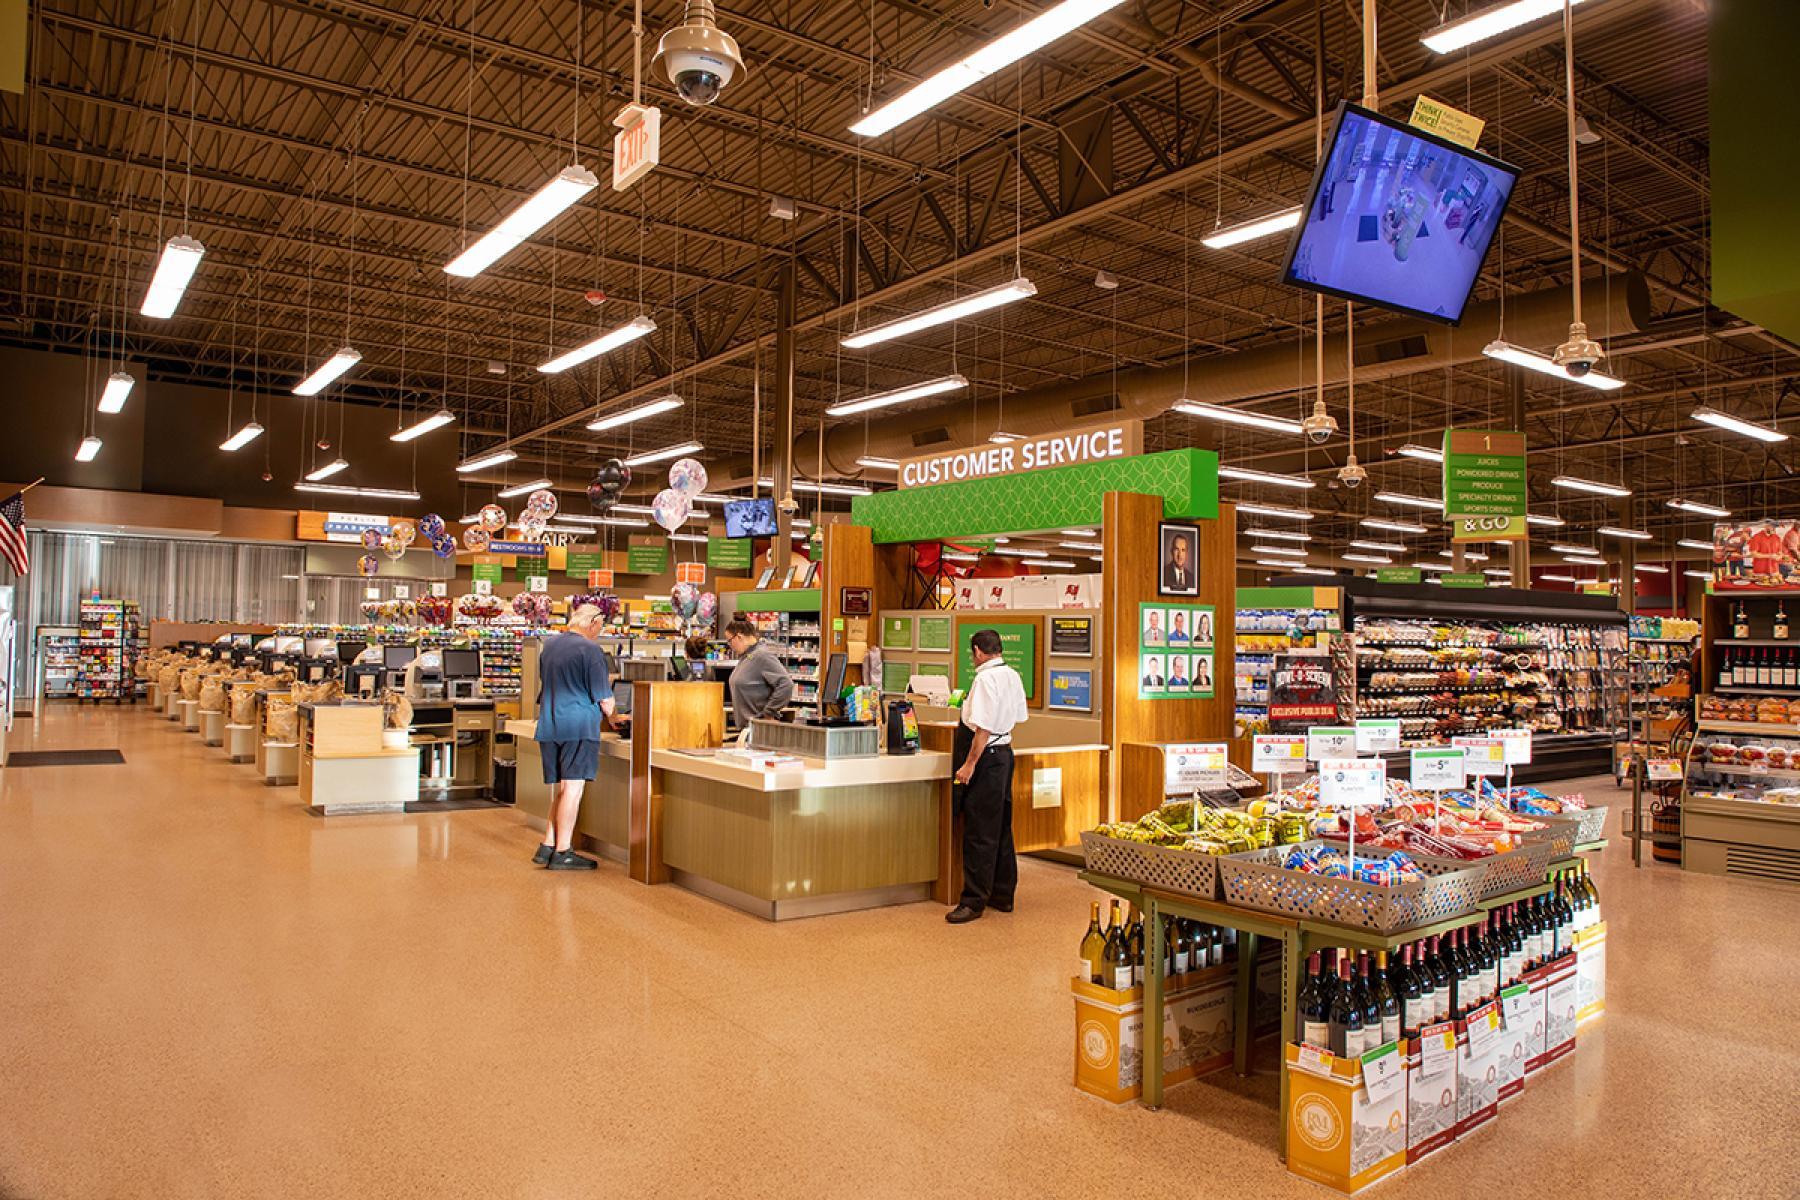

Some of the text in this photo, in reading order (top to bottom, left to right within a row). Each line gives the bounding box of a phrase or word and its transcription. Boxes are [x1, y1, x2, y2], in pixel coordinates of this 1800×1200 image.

[619, 120, 645, 176] EXIT
[903, 428, 1123, 486] CUSTOMER SERVICE
[1483, 435, 1491, 451] 1
[1480, 516, 1509, 531] GO
